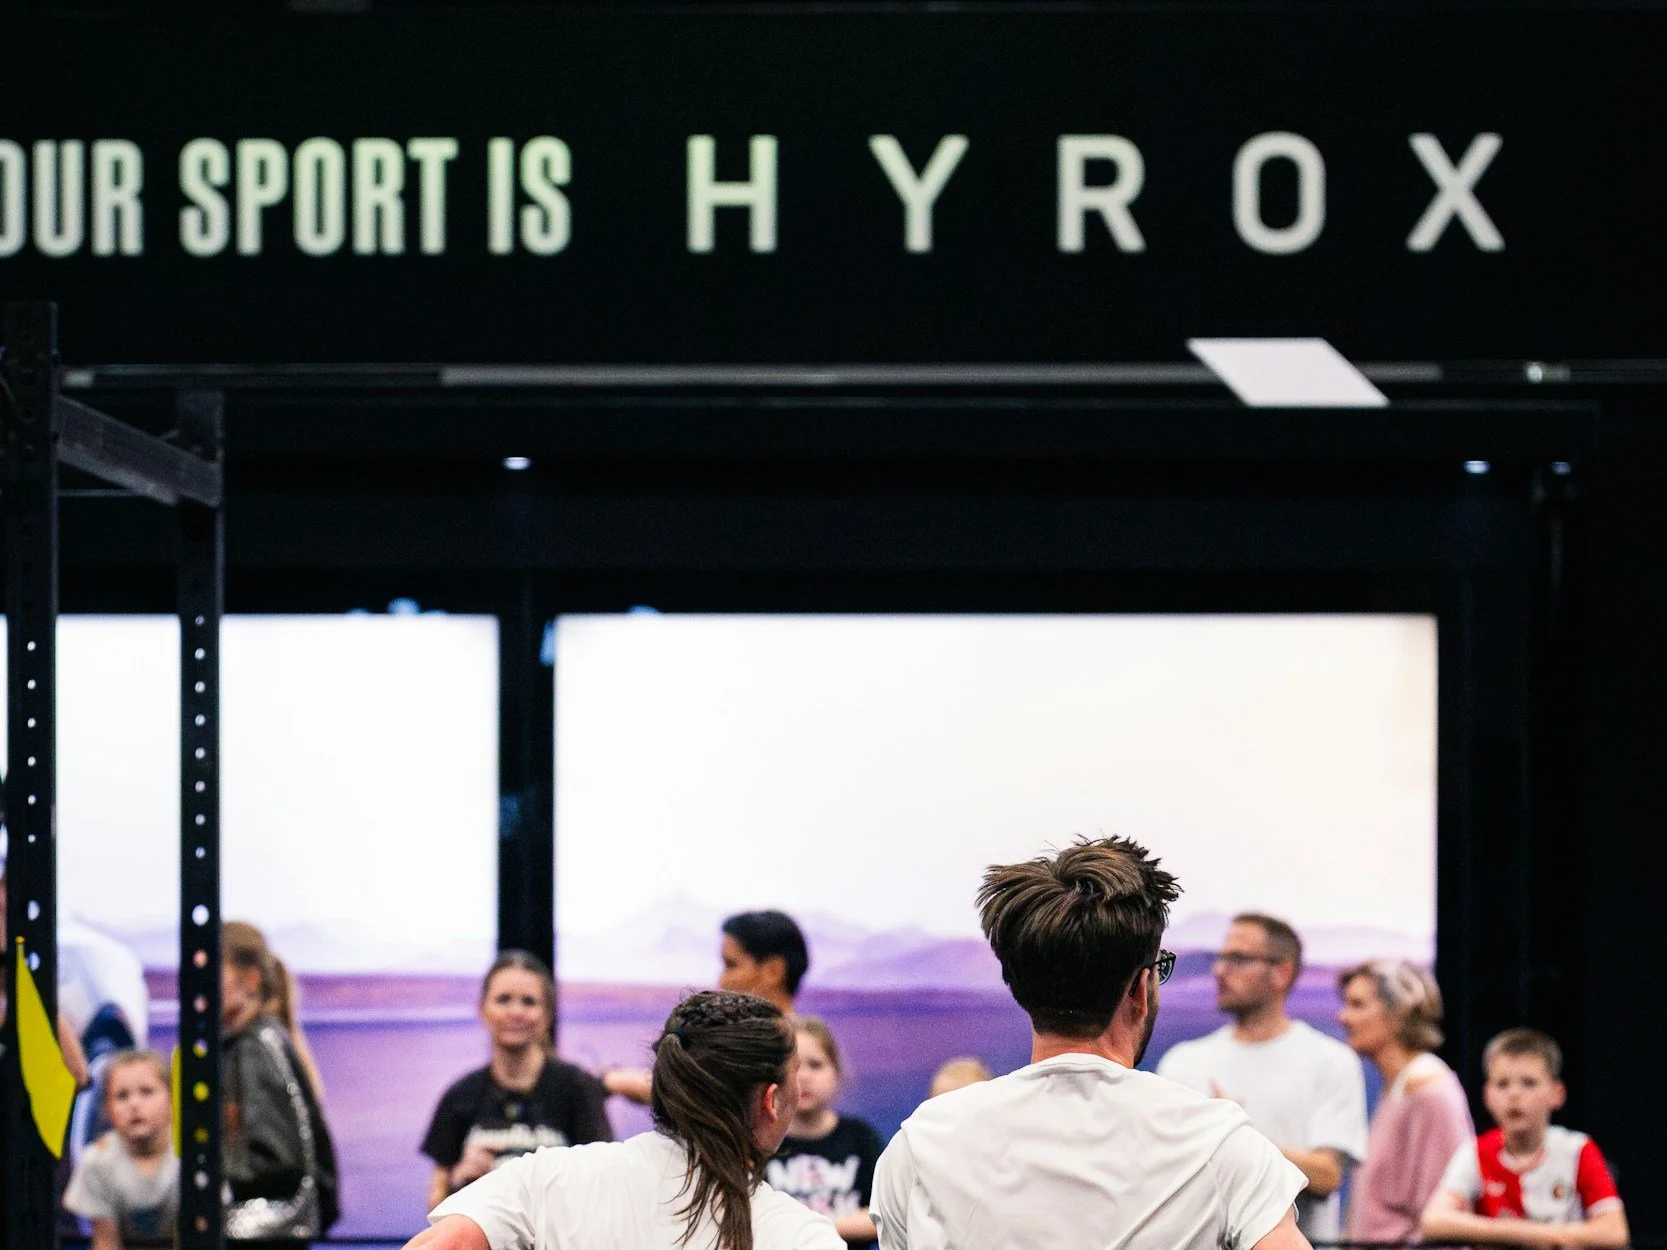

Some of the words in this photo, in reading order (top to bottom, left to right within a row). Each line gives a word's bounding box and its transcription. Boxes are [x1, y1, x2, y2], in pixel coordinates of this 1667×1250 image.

[179, 136, 459, 257] SPORT
[487, 135, 573, 256] IS
[686, 131, 1504, 255] HYROX
